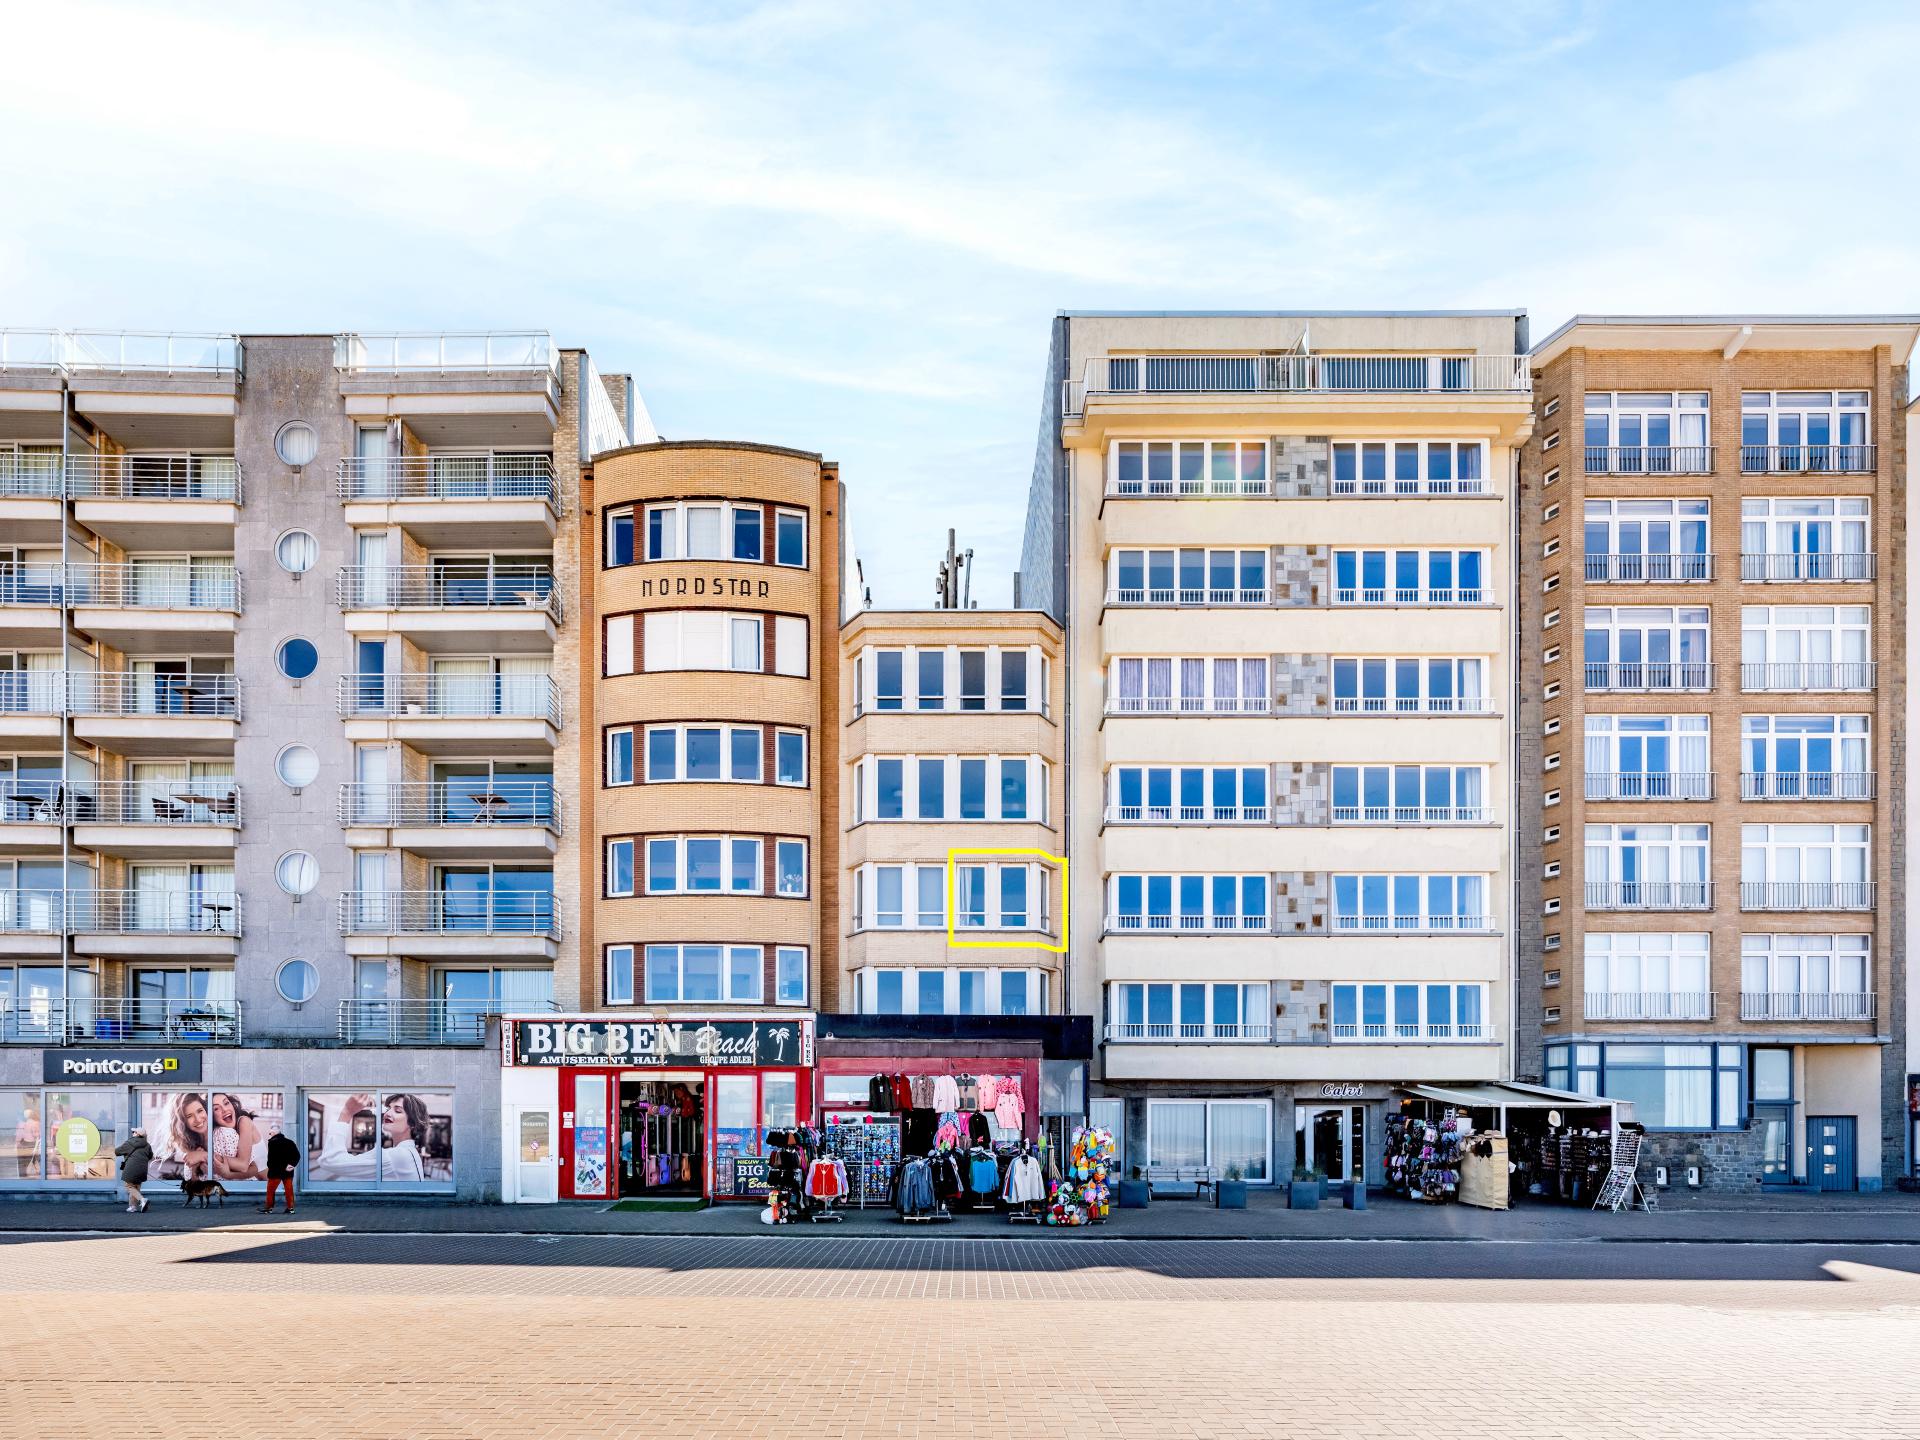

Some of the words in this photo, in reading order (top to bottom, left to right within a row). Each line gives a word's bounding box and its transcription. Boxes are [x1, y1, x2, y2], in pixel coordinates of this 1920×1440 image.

[643, 578, 769, 598] NORDSTAR
[528, 1023, 594, 1054] BIG
[604, 1023, 682, 1054] BEN
[695, 1026, 759, 1055] Beach
[63, 1058, 164, 1075] PointCarré
[540, 1056, 627, 1064] AMUSEMENT
[633, 1056, 668, 1064] HALL
[700, 1055, 727, 1064] GROUPE
[1321, 1082, 1364, 1097] Calvi
[737, 1165, 765, 1176] BIG
